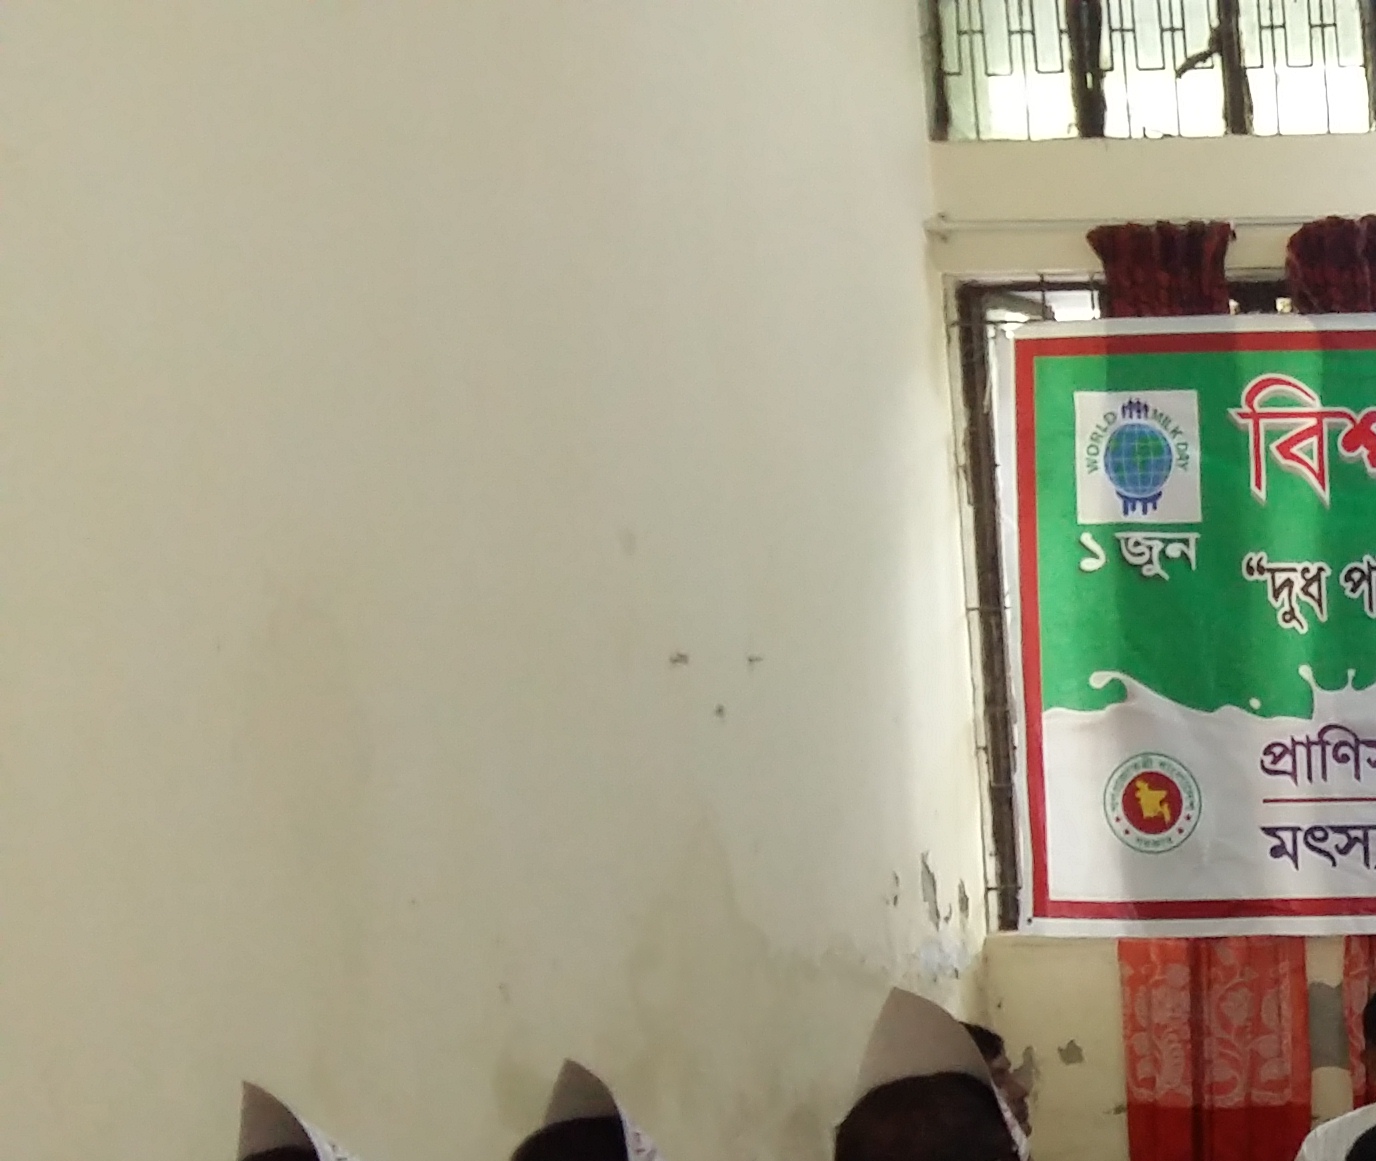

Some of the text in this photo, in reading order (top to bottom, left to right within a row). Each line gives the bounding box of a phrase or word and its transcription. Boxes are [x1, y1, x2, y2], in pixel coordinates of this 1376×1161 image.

[1086, 408, 1190, 475] WORLD MILK DAY
[1079, 531, 1199, 579] ১ জুন
